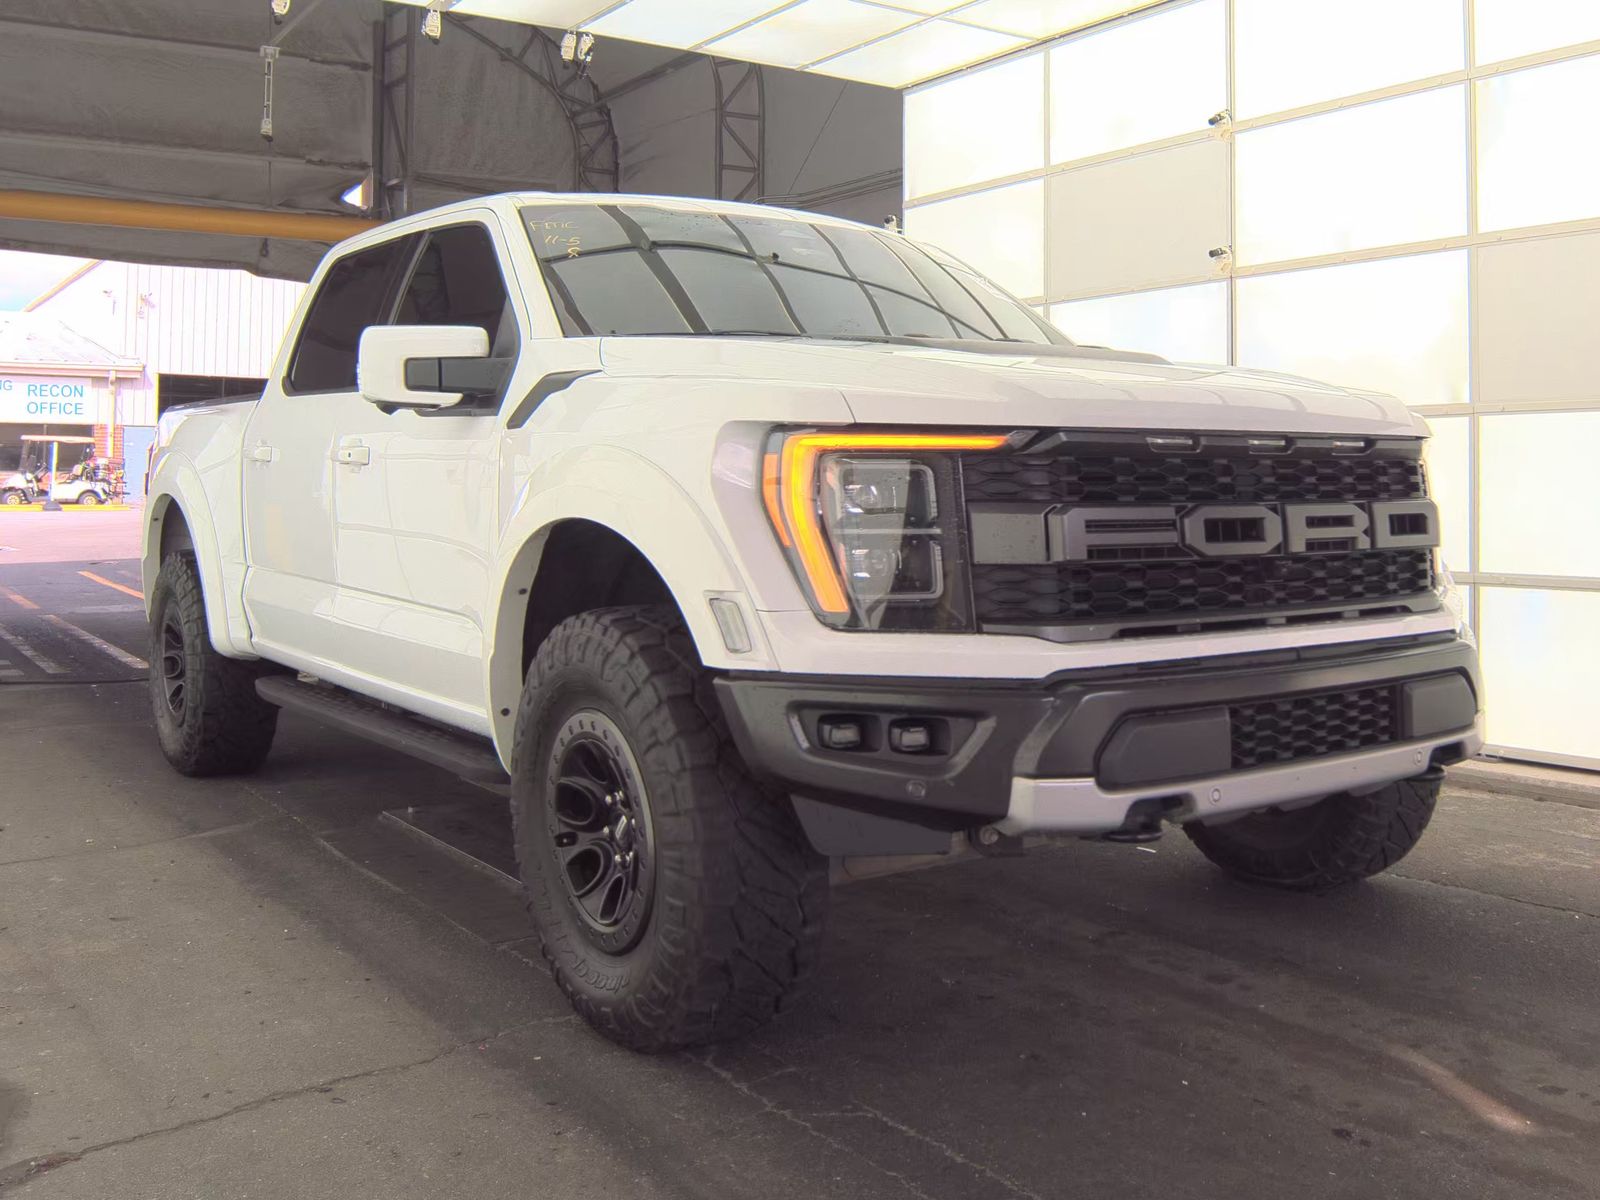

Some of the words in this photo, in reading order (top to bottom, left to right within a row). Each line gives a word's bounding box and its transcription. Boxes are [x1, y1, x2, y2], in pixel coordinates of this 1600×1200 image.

[0, 379, 13, 391] G
[27, 384, 84, 398] RECON
[27, 402, 84, 415] OFFICE
[1048, 499, 1440, 562] FORD
